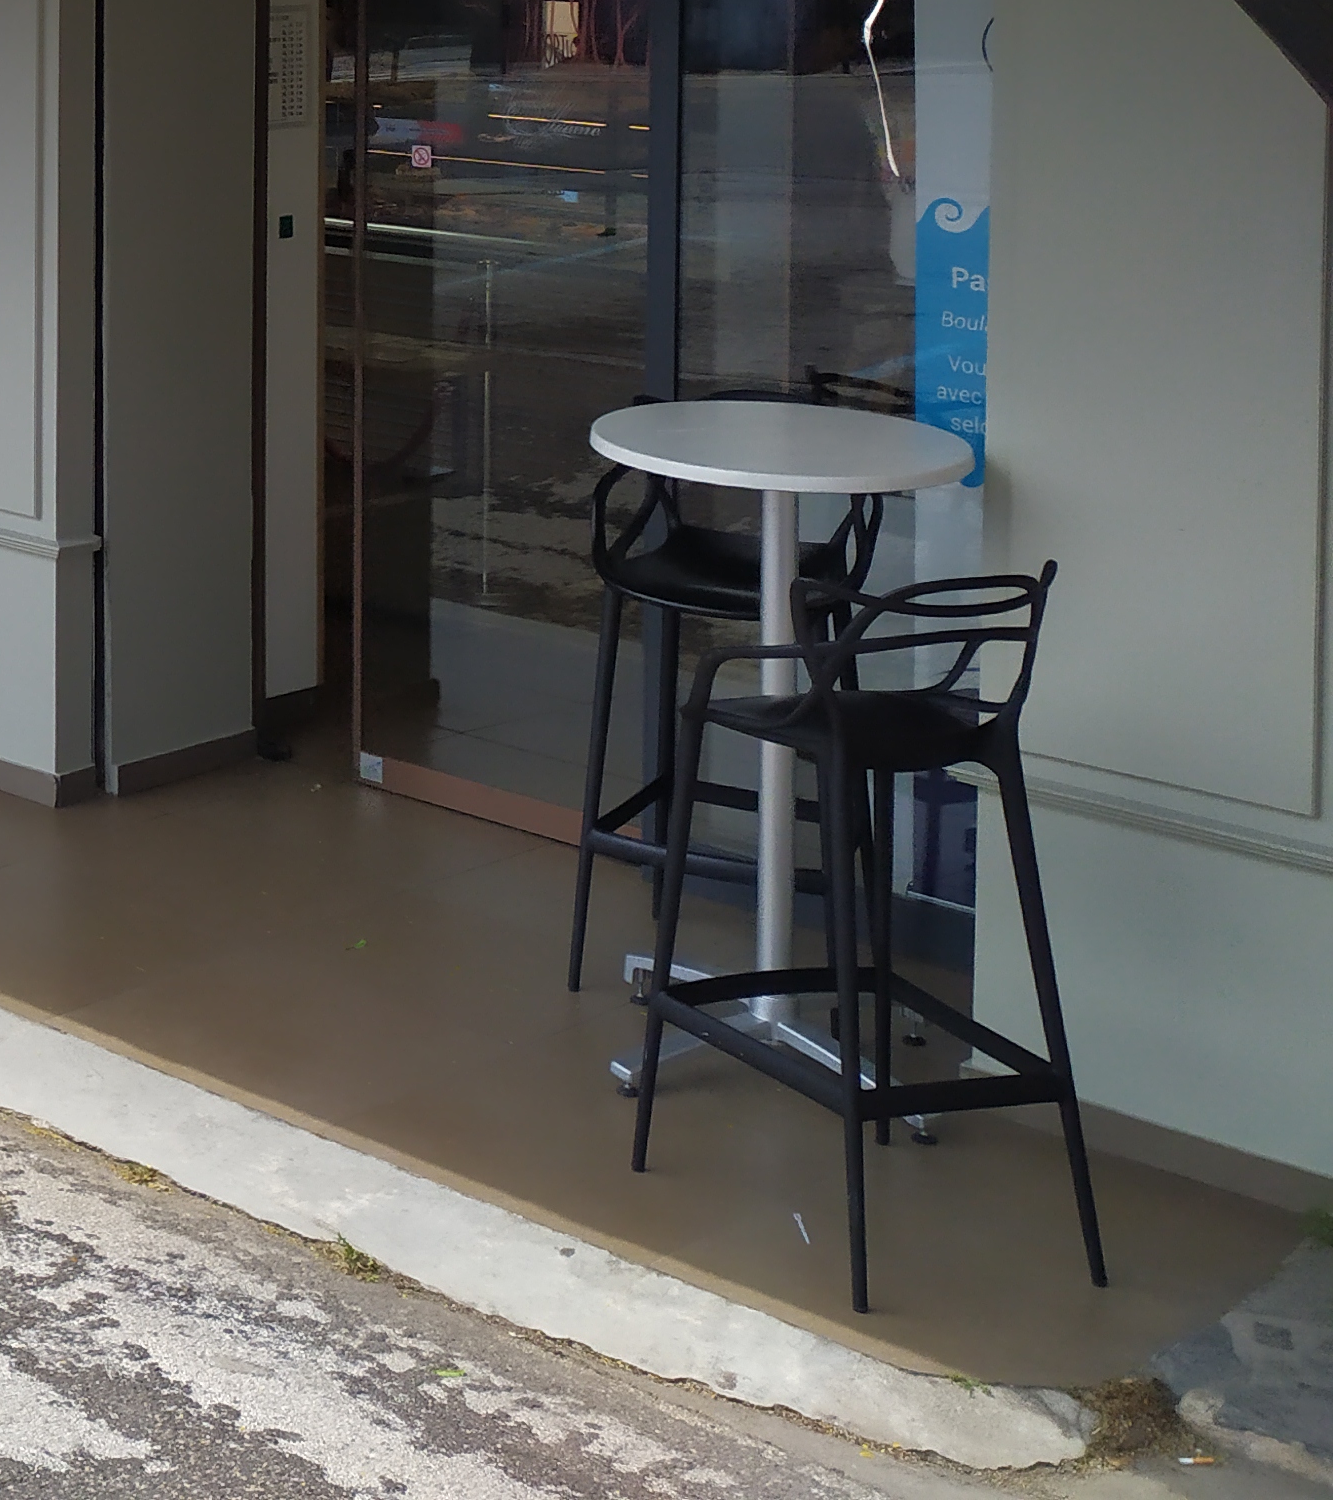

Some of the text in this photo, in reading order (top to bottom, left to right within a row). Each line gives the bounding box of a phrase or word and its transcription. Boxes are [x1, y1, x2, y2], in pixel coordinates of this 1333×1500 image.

[951, 266, 989, 292] Pa
[941, 310, 988, 332] Boul
[936, 385, 983, 405] avec
